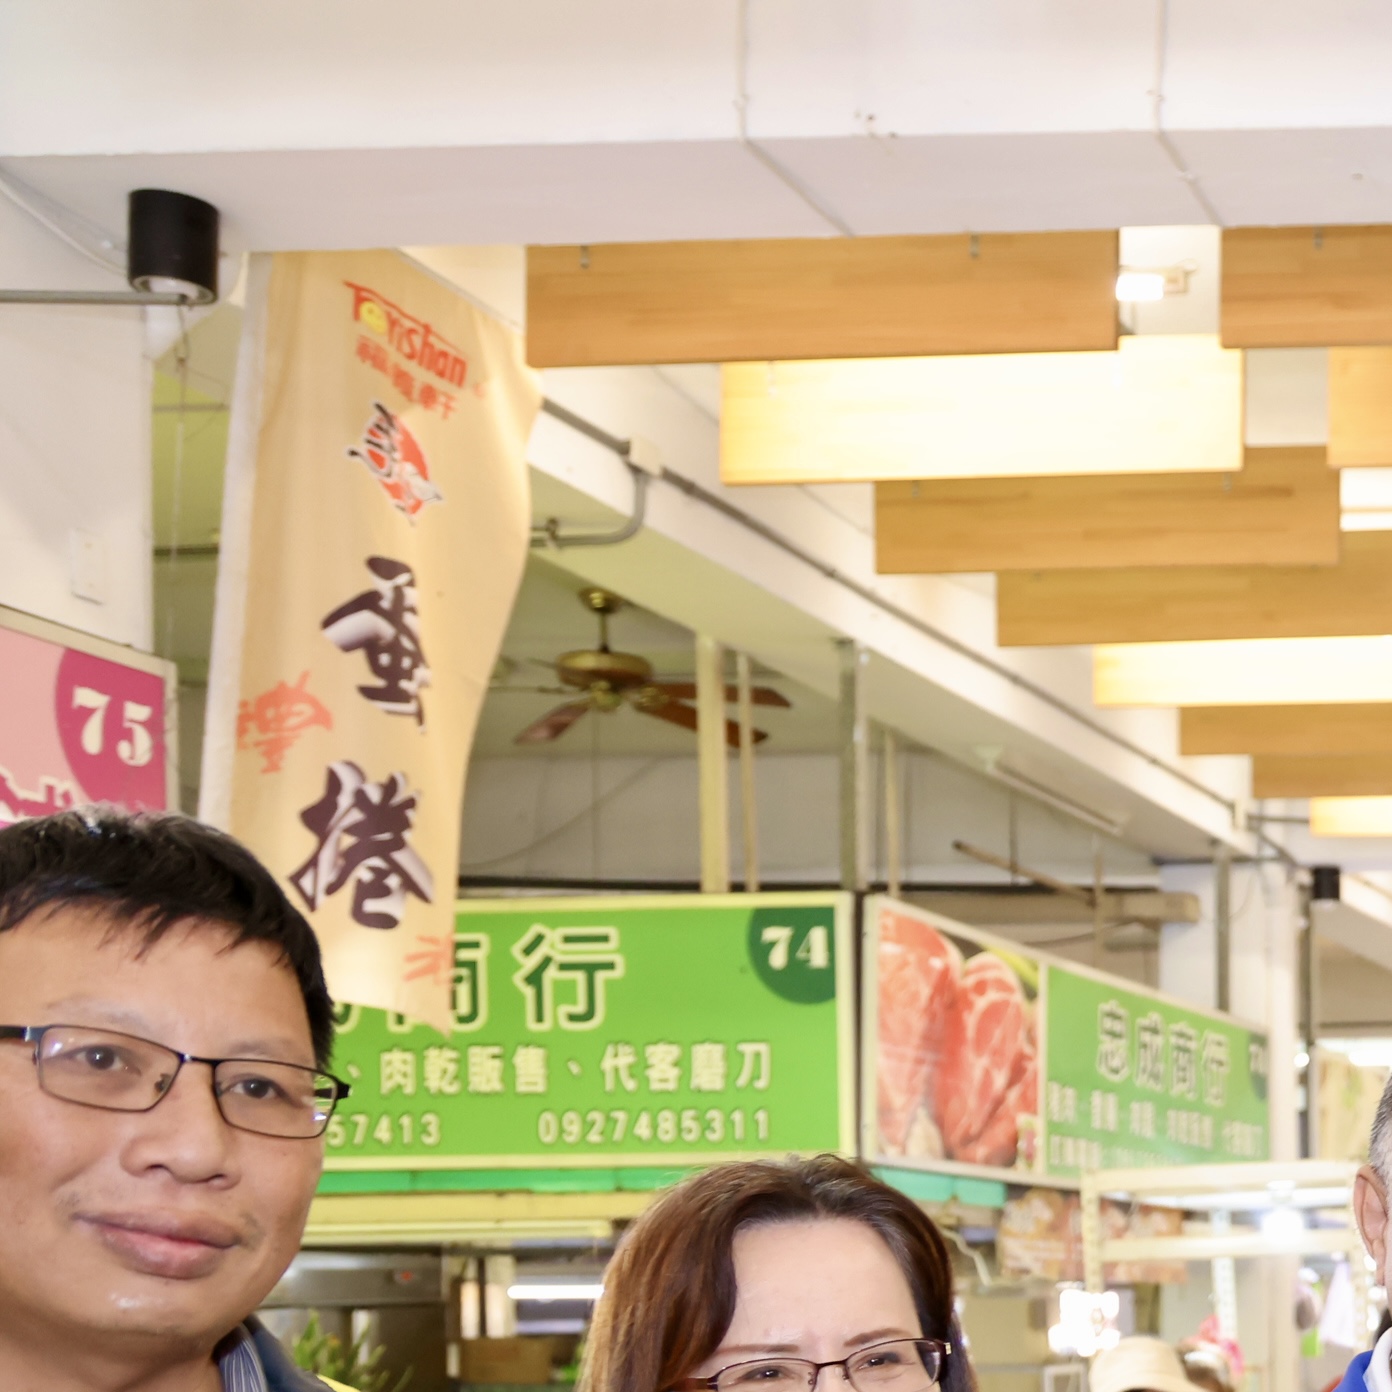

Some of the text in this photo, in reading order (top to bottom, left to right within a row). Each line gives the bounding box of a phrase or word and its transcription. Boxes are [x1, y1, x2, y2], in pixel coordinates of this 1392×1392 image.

[73, 686, 153, 767] 75
[761, 925, 830, 971] 74
[538, 1108, 770, 1144] 0927485311
